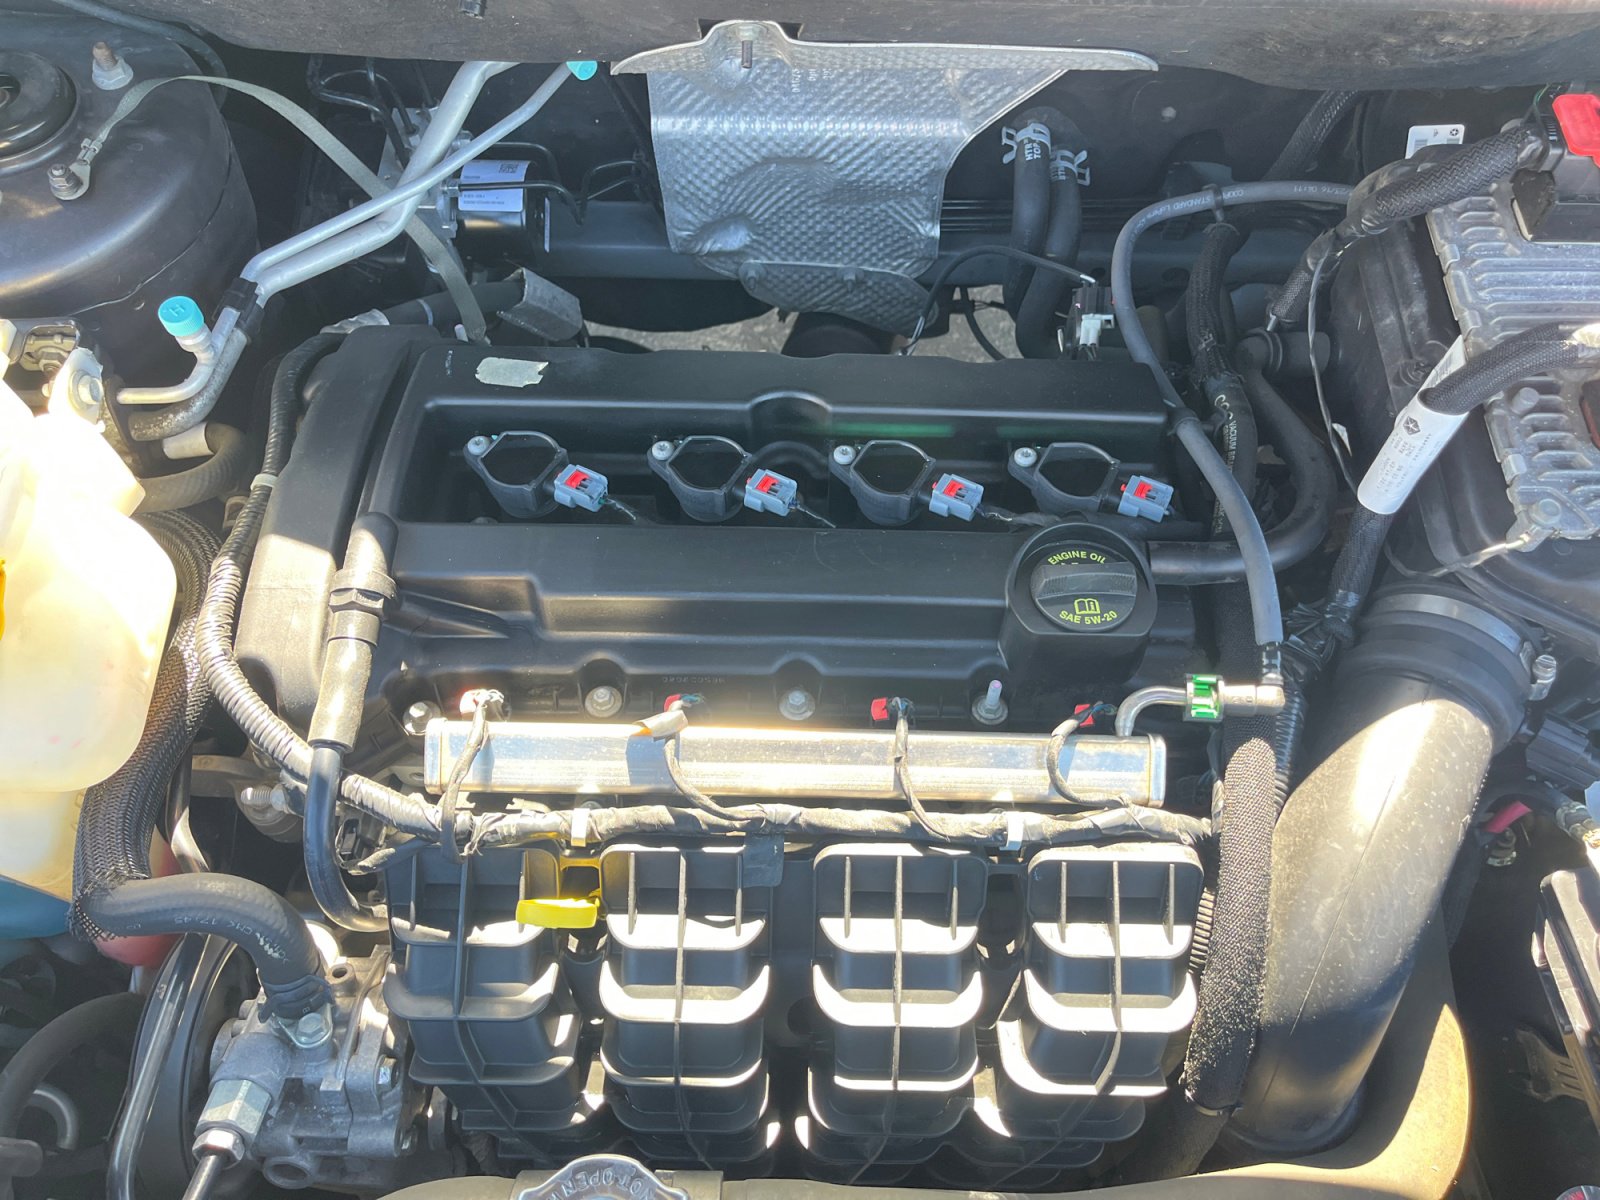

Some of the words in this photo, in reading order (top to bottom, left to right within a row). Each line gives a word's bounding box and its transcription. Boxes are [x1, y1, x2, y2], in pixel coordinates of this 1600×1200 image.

[1228, 420, 1237, 450] VACUUM
[1047, 550, 1087, 565] ENGINE
[1089, 552, 1106, 564] OIL
[1059, 610, 1082, 624] SAE
[1084, 610, 1118, 625] 5W-20
[561, 1168, 616, 1198] OPEN
